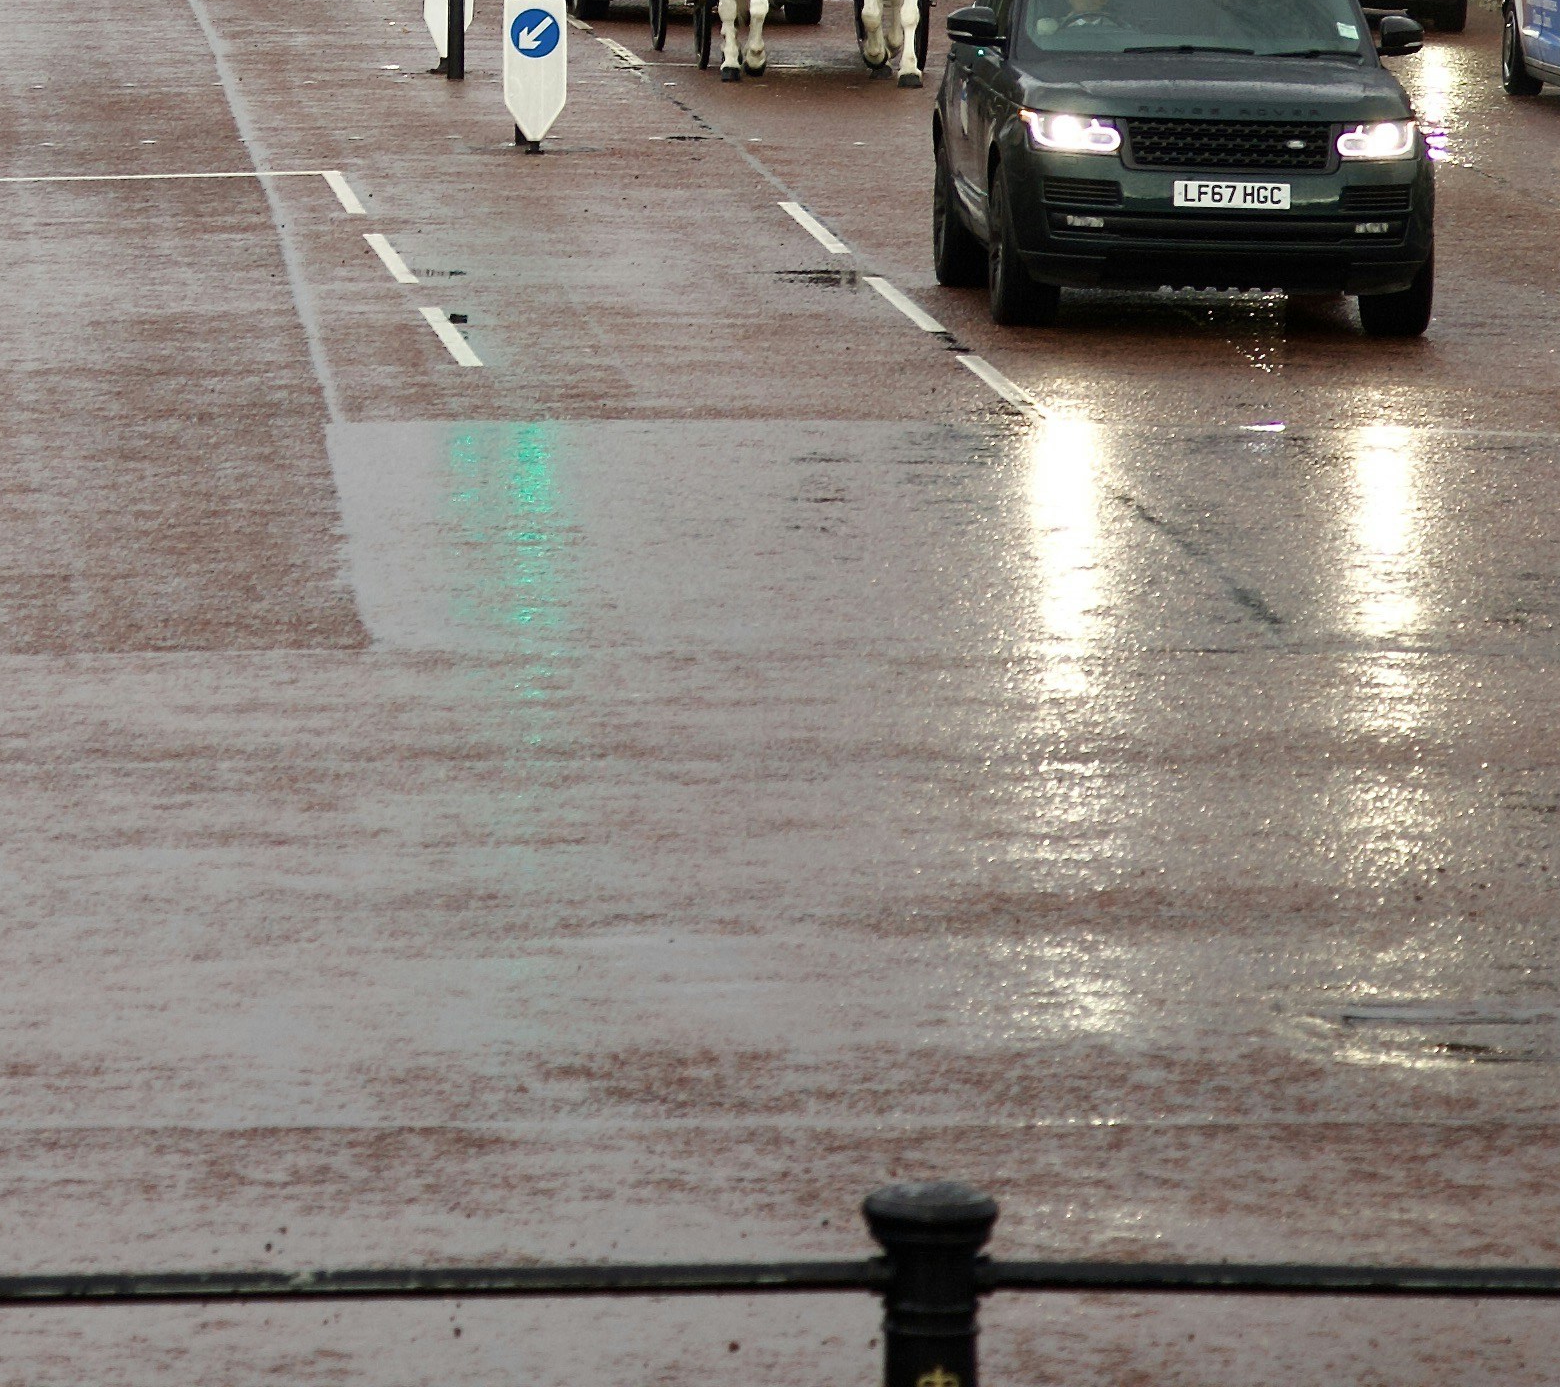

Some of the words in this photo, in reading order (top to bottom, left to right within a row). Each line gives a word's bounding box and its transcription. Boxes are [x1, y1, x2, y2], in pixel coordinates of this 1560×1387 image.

[1138, 105, 1220, 116] RANGE
[1239, 107, 1321, 117] ROVER
[1183, 183, 1237, 204] LF67
[1242, 185, 1282, 205] HGC
